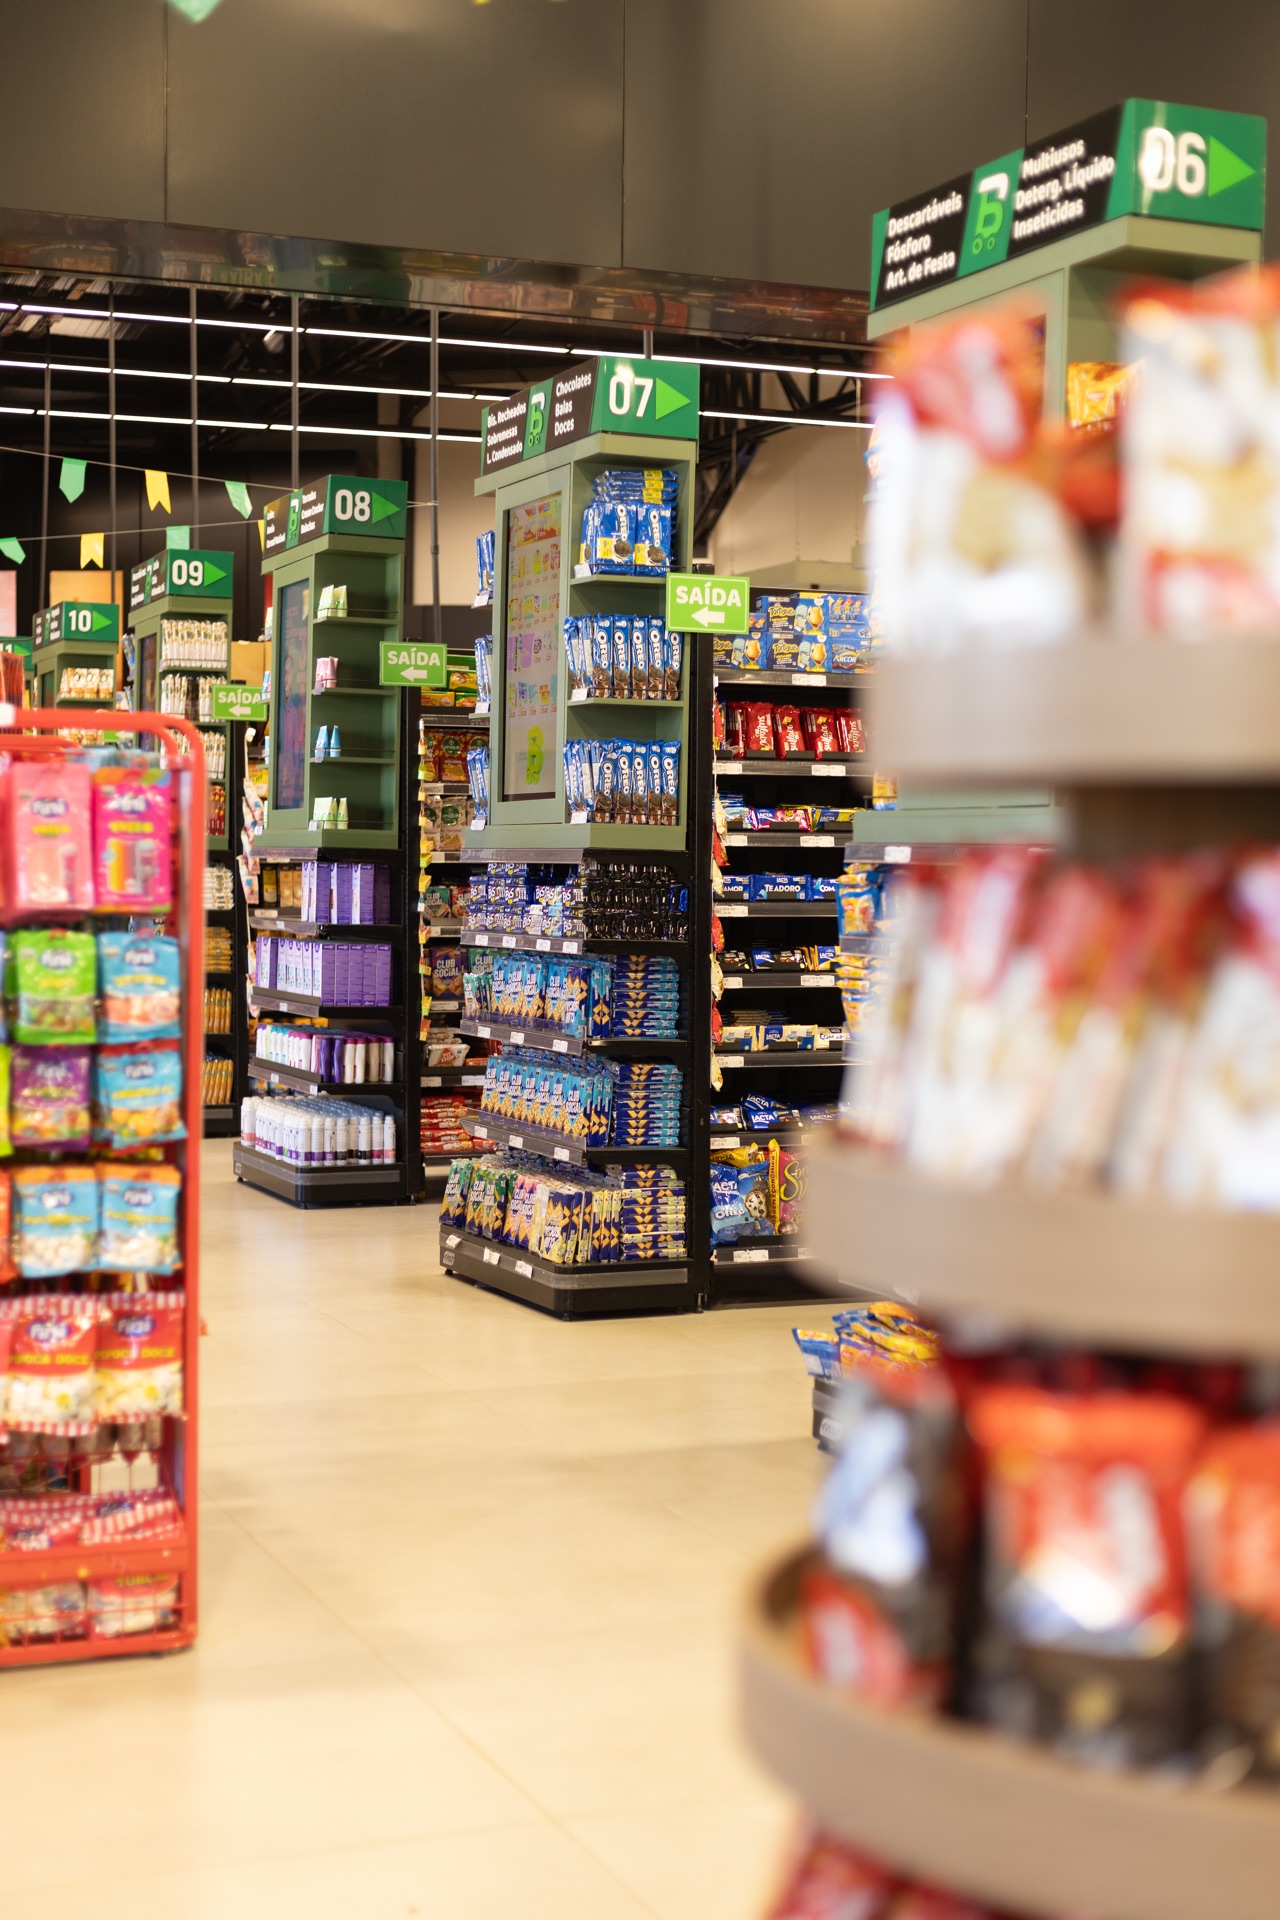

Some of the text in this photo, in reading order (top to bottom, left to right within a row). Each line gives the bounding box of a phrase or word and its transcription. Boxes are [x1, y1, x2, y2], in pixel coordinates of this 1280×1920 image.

[1021, 138, 1086, 178] Multiusos
[1139, 127, 1207, 195] 06
[1014, 155, 1116, 209] Deterg. Líquido
[886, 191, 964, 238] Descartáveis
[1012, 197, 1084, 241] Inseticidas
[885, 233, 931, 265] Fósforo
[885, 249, 956, 291] Art. de Festa
[556, 373, 592, 397] Chocolates
[608, 374, 654, 418] 07
[497, 402, 527, 424] Recheados
[555, 399, 573, 418] Balas
[487, 425, 518, 447] Sobremesas
[554, 418, 575, 437] Doces
[491, 440, 523, 463] Condensado
[335, 489, 371, 522] 08
[616, 504, 628, 542] OREO
[648, 510, 660, 548] OREO
[172, 559, 203, 587] 09
[676, 582, 742, 608] SAÍDA
[68, 609, 92, 633] 10
[387, 647, 441, 667] SAÍDA
[597, 630, 609, 669] OREO
[614, 629, 626, 670] OREO
[632, 629, 645, 670] OREO
[649, 628, 662, 668] OREO
[670, 631, 680, 670] OREO
[833, 654, 857, 663] ARCOR
[218, 688, 262, 704] SAÍDA
[602, 761, 613, 796] OREO
[619, 755, 630, 794] OREO
[633, 756, 645, 795] OREO
[649, 754, 661, 794] OREO
[663, 756, 676, 795] OREO
[774, 884, 801, 892] ADORO
[436, 958, 456, 969] CLUB
[747, 1094, 770, 1108] LACTA
[714, 1208, 745, 1219] OREO
[55, 1354, 90, 1367] DOCE
[141, 1347, 175, 1360] DOCE
